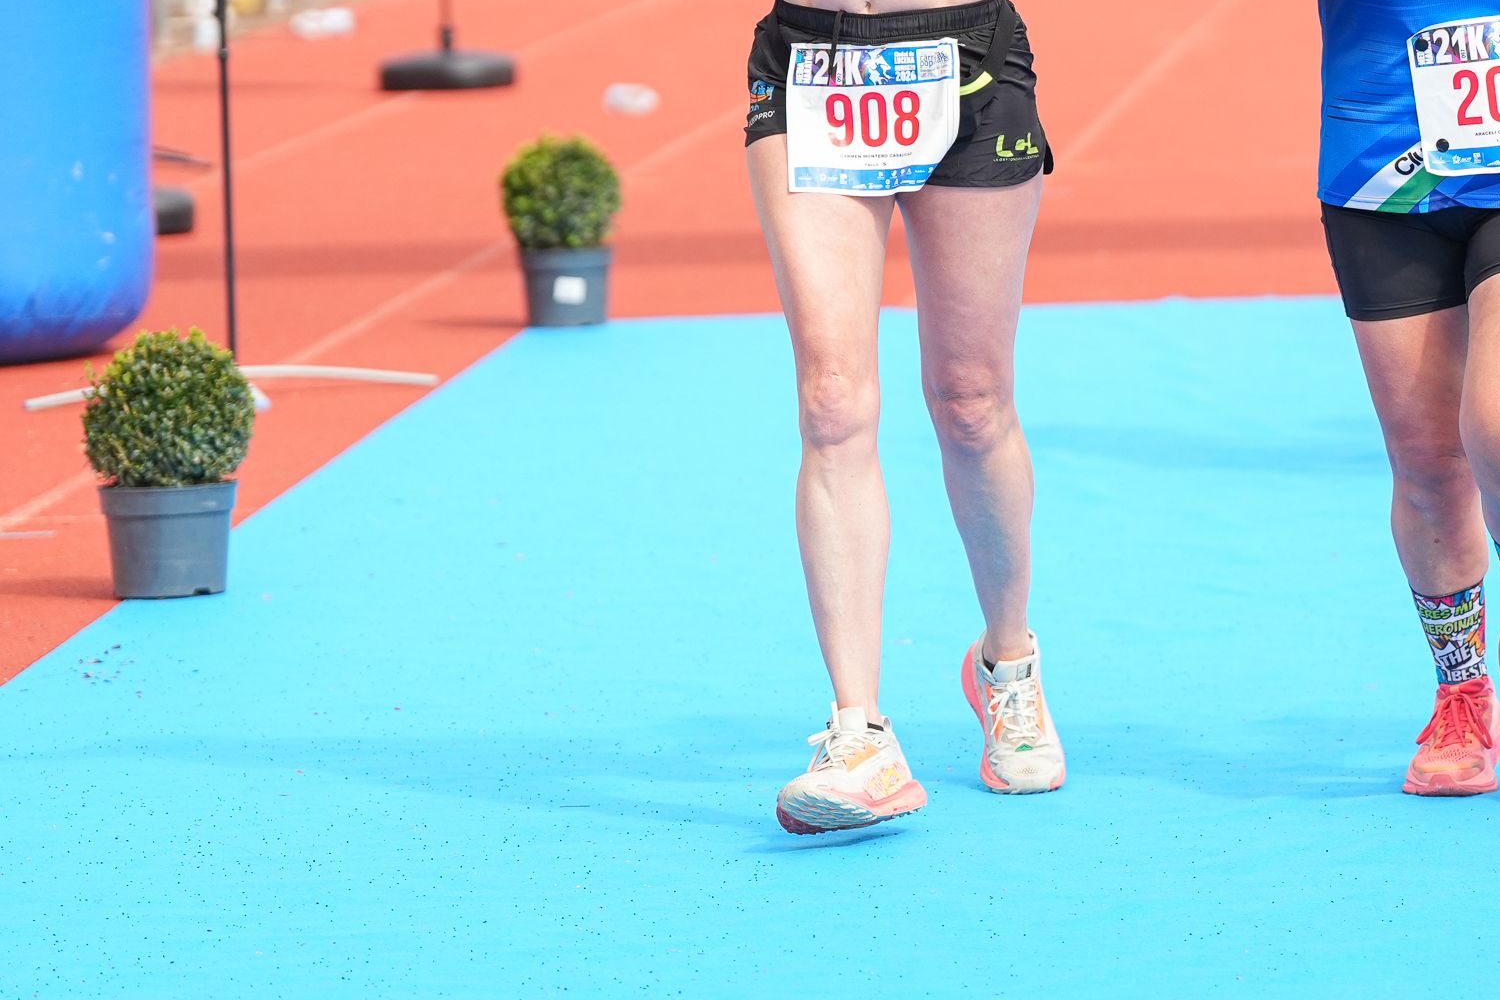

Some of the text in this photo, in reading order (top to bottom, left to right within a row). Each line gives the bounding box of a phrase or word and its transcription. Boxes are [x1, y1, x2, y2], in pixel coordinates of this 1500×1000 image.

[1433, 24, 1489, 63] 21K
[812, 49, 864, 86] 21K
[825, 89, 921, 148] 908
[1419, 599, 1474, 619] ERES MI
[1440, 641, 1472, 668] THE
